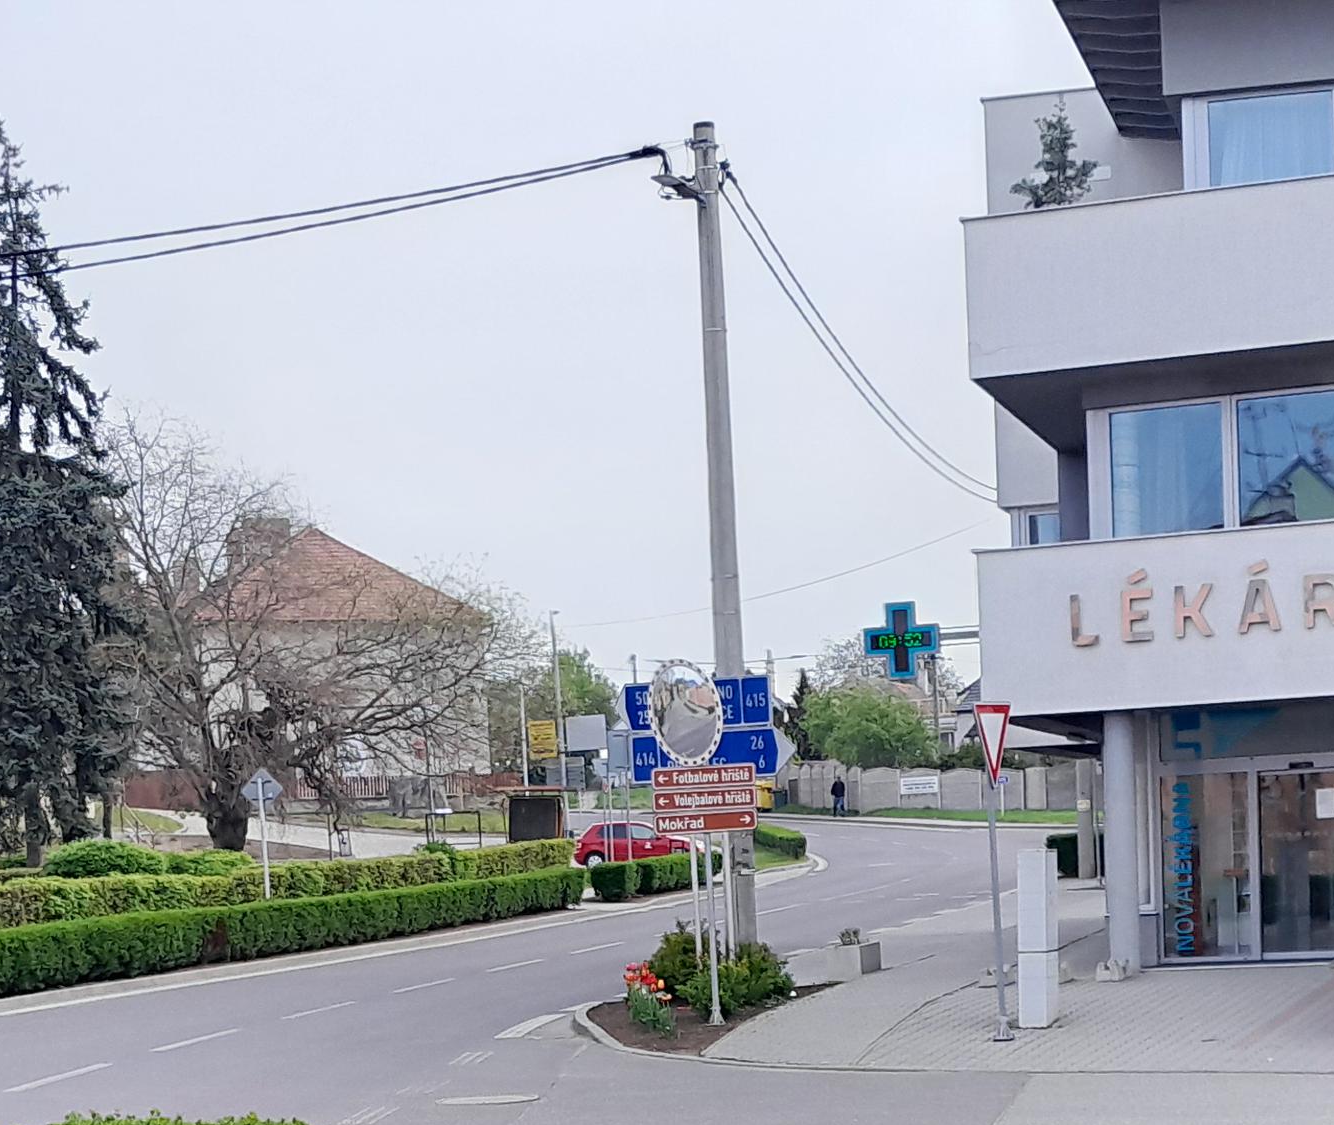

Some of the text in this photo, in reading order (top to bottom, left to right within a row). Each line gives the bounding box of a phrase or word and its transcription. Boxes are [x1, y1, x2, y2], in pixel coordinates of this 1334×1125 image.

[878, 633, 922, 648] 09:52
[745, 692, 766, 707] 415
[750, 736, 764, 749] 26
[635, 752, 655, 767] 414
[758, 755, 765, 768] 6
[672, 768, 749, 784] Fotbalové hřiště
[673, 790, 751, 808] Volejbalové hřiště
[659, 816, 704, 831] Mokřad
